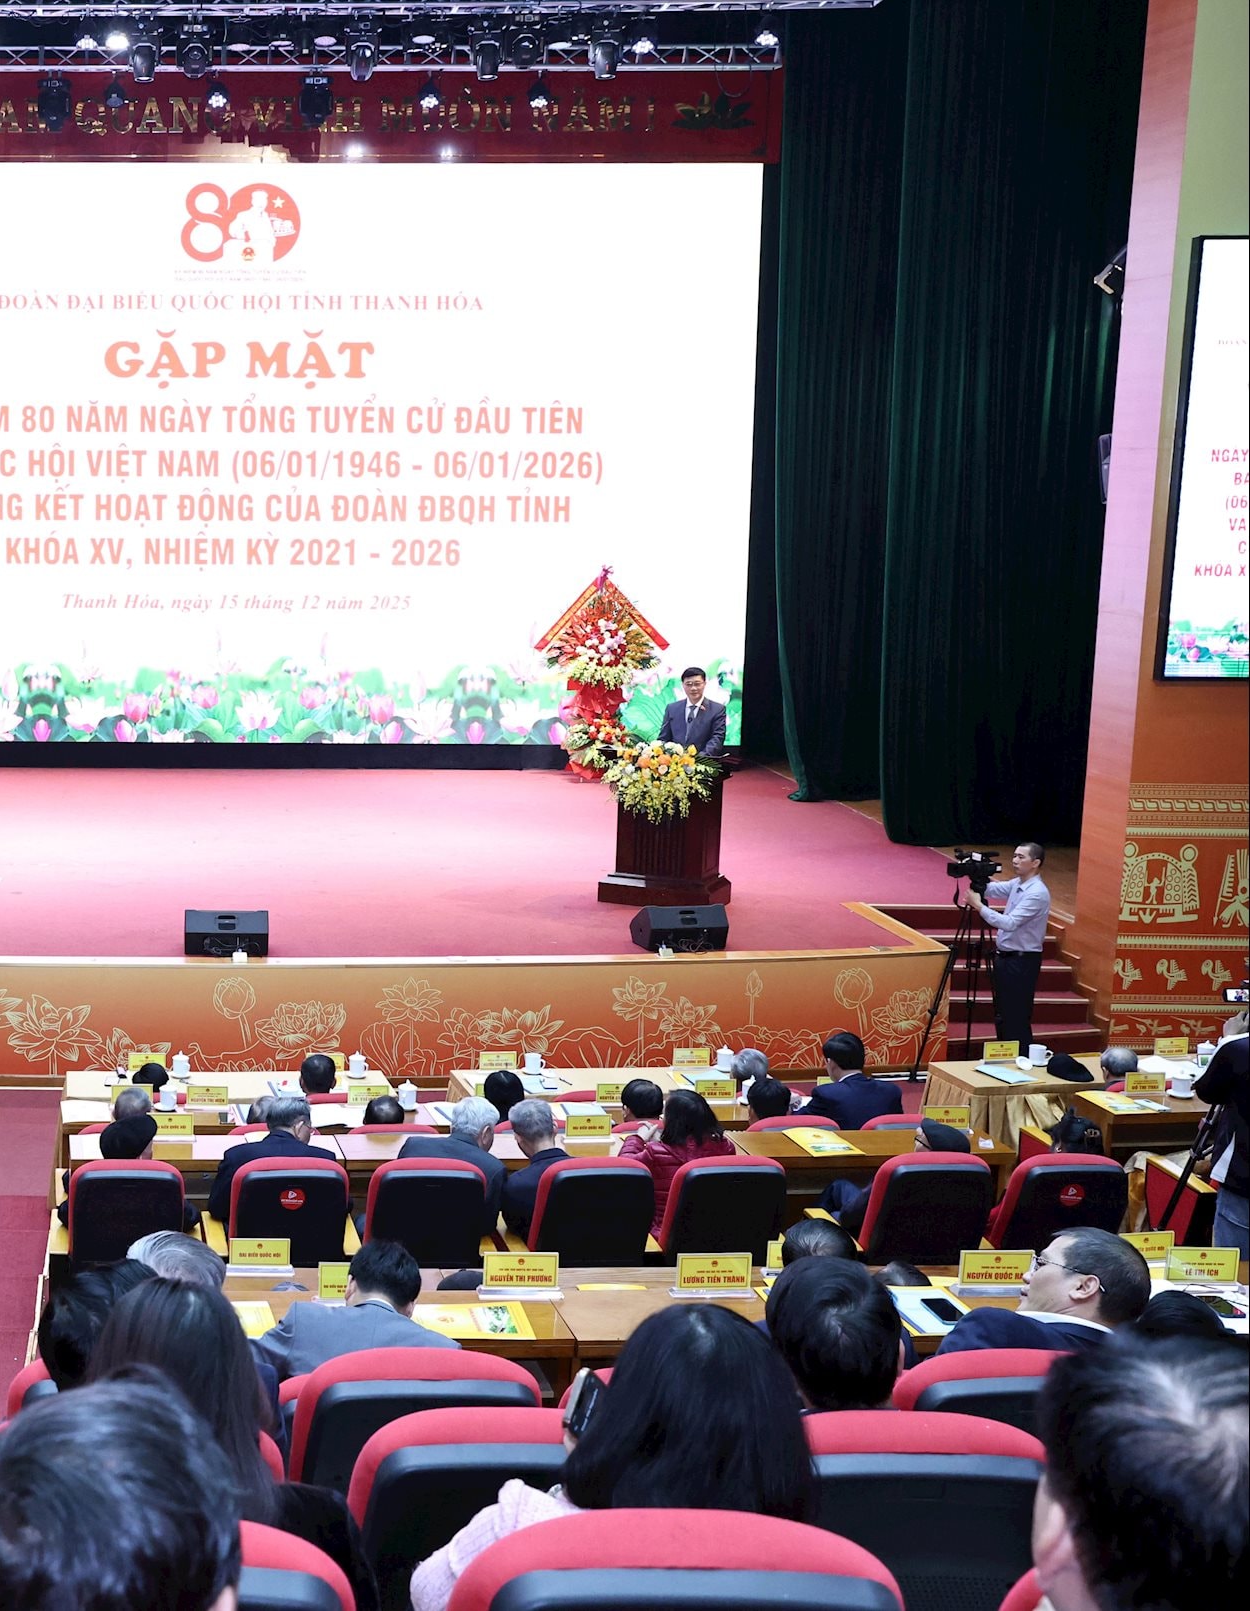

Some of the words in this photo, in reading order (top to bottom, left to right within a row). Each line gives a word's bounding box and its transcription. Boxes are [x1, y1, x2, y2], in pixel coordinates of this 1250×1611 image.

[75, 97, 233, 137] QUANG
[250, 97, 365, 133] VIH
[67, 294, 103, 312] ĐẠI
[350, 295, 428, 310] THANH
[437, 291, 483, 310] HÓA
[104, 329, 226, 389] GẶP
[246, 329, 375, 390] MẶT
[22, 405, 54, 433] 80
[66, 400, 127, 433] NĂM
[140, 399, 211, 433] NGÀY
[223, 393, 295, 433] TỔNG
[307, 393, 395, 434] TUYỂN
[407, 397, 446, 434] CỬ
[454, 396, 510, 434] ĐẦU
[522, 399, 583, 434] TIÊN
[28, 442, 75, 483] HỘI
[87, 442, 147, 483] VIỆT
[158, 450, 219, 477] NAM
[232, 450, 400, 483] (06/01/1946
[434, 451, 603, 485] 06/01/2026)
[35, 484, 84, 521] KẾT
[95, 494, 168, 528] HOẠT
[177, 487, 254, 528] ĐỘNG
[265, 486, 321, 522] CỦA
[331, 488, 407, 522] ĐOÀN
[418, 495, 495, 525] ĐBQH
[507, 487, 570, 523] TỈNH
[6, 530, 79, 565] KHÓA
[90, 538, 132, 569] XV,
[144, 531, 234, 571] NHIỆM
[247, 531, 279, 566] KỲ
[290, 539, 355, 566] 2021
[392, 539, 460, 566] 2026
[61, 594, 117, 609] Thanh
[124, 594, 165, 611] Hóa,
[171, 596, 213, 612] ngày
[220, 595, 239, 610] 15
[244, 595, 294, 613] tháng
[301, 595, 320, 610] 12
[326, 597, 363, 610] năm
[370, 595, 412, 610] 2025
[490, 1273, 514, 1282] NGUYỄN
[515, 1274, 525, 1284] THỊ
[683, 1275, 705, 1284] LƯƠNG
[966, 1271, 993, 1283] NGUYỄN
[994, 1271, 1013, 1283] QUỐC
[1185, 1266, 1193, 1276] LÊ
